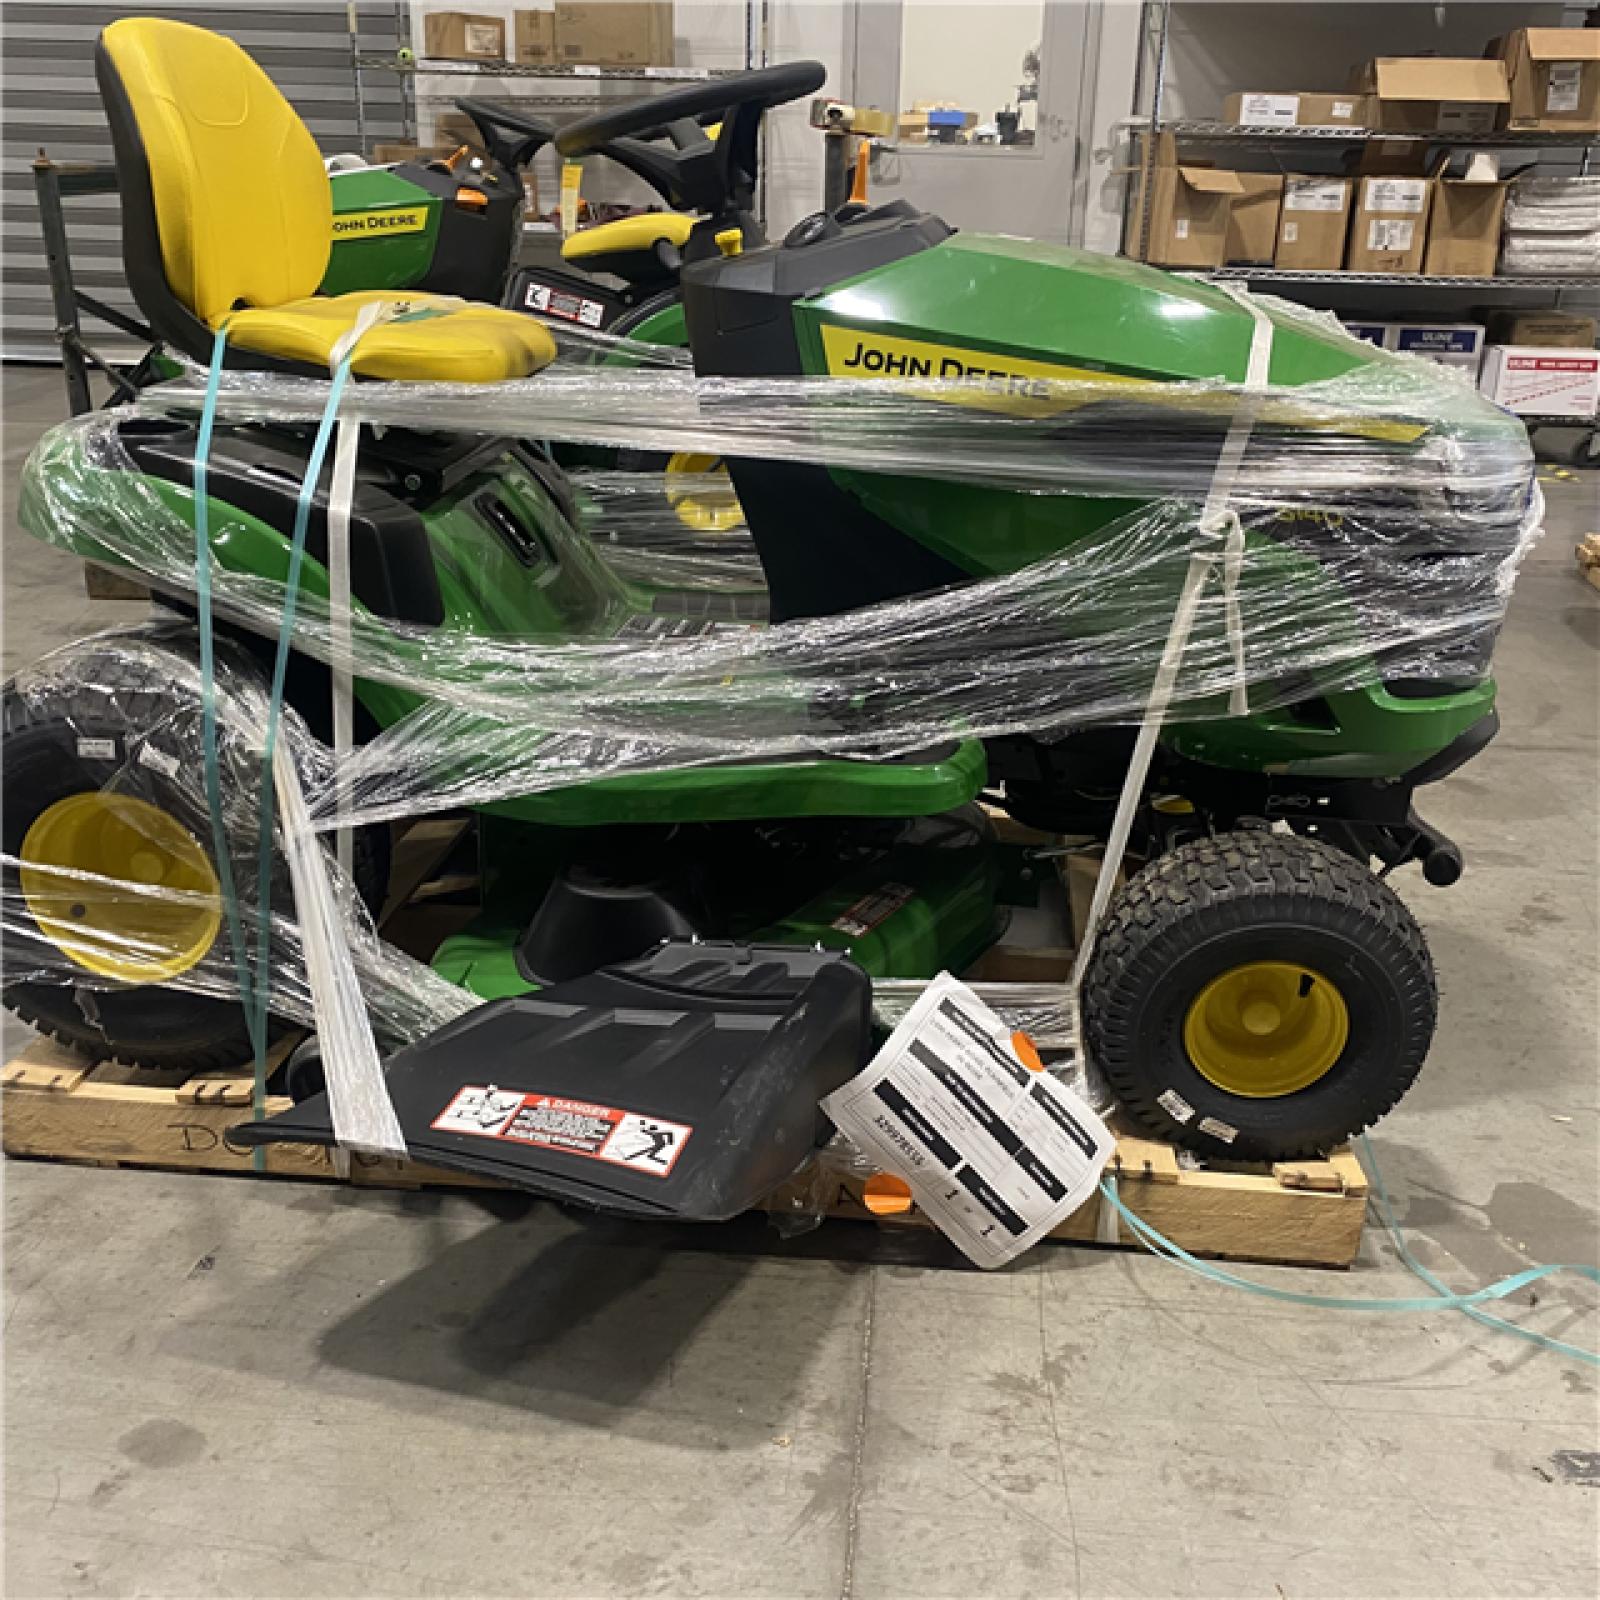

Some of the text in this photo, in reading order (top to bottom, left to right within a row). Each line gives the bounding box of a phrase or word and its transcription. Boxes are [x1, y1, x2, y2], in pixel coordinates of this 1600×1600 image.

[332, 214, 417, 233] OHN DEERE
[843, 342, 1052, 400] JOHN DEERE
